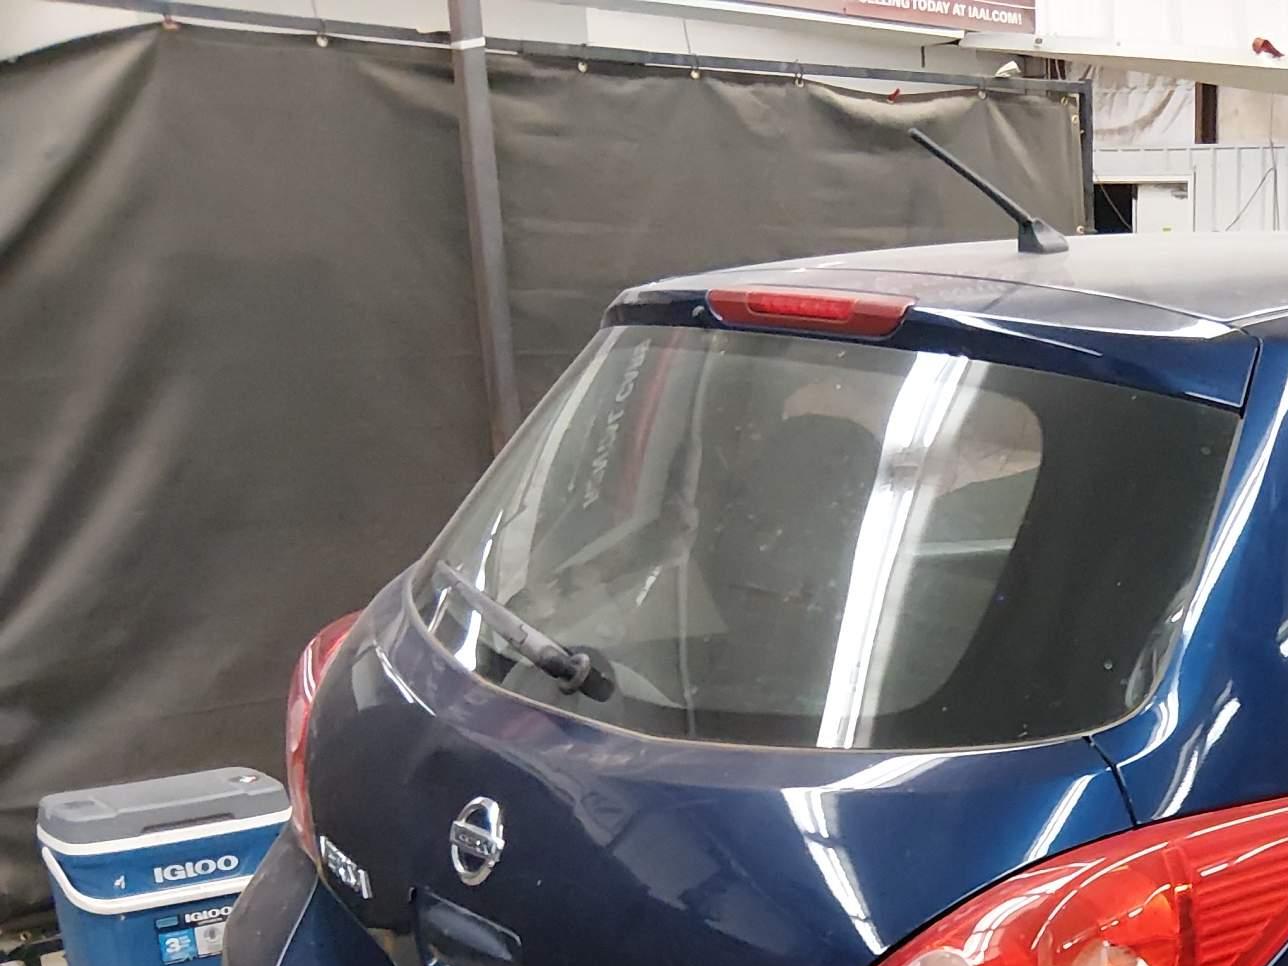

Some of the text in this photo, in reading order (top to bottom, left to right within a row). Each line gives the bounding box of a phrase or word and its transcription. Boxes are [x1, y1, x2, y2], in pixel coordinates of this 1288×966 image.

[859, 0, 910, 9] LLING
[912, 0, 951, 14] TODAY
[953, 4, 966, 17] AT
[153, 854, 239, 883] IGLOO
[184, 906, 233, 923] IGLOO
[165, 938, 181, 953] 3
